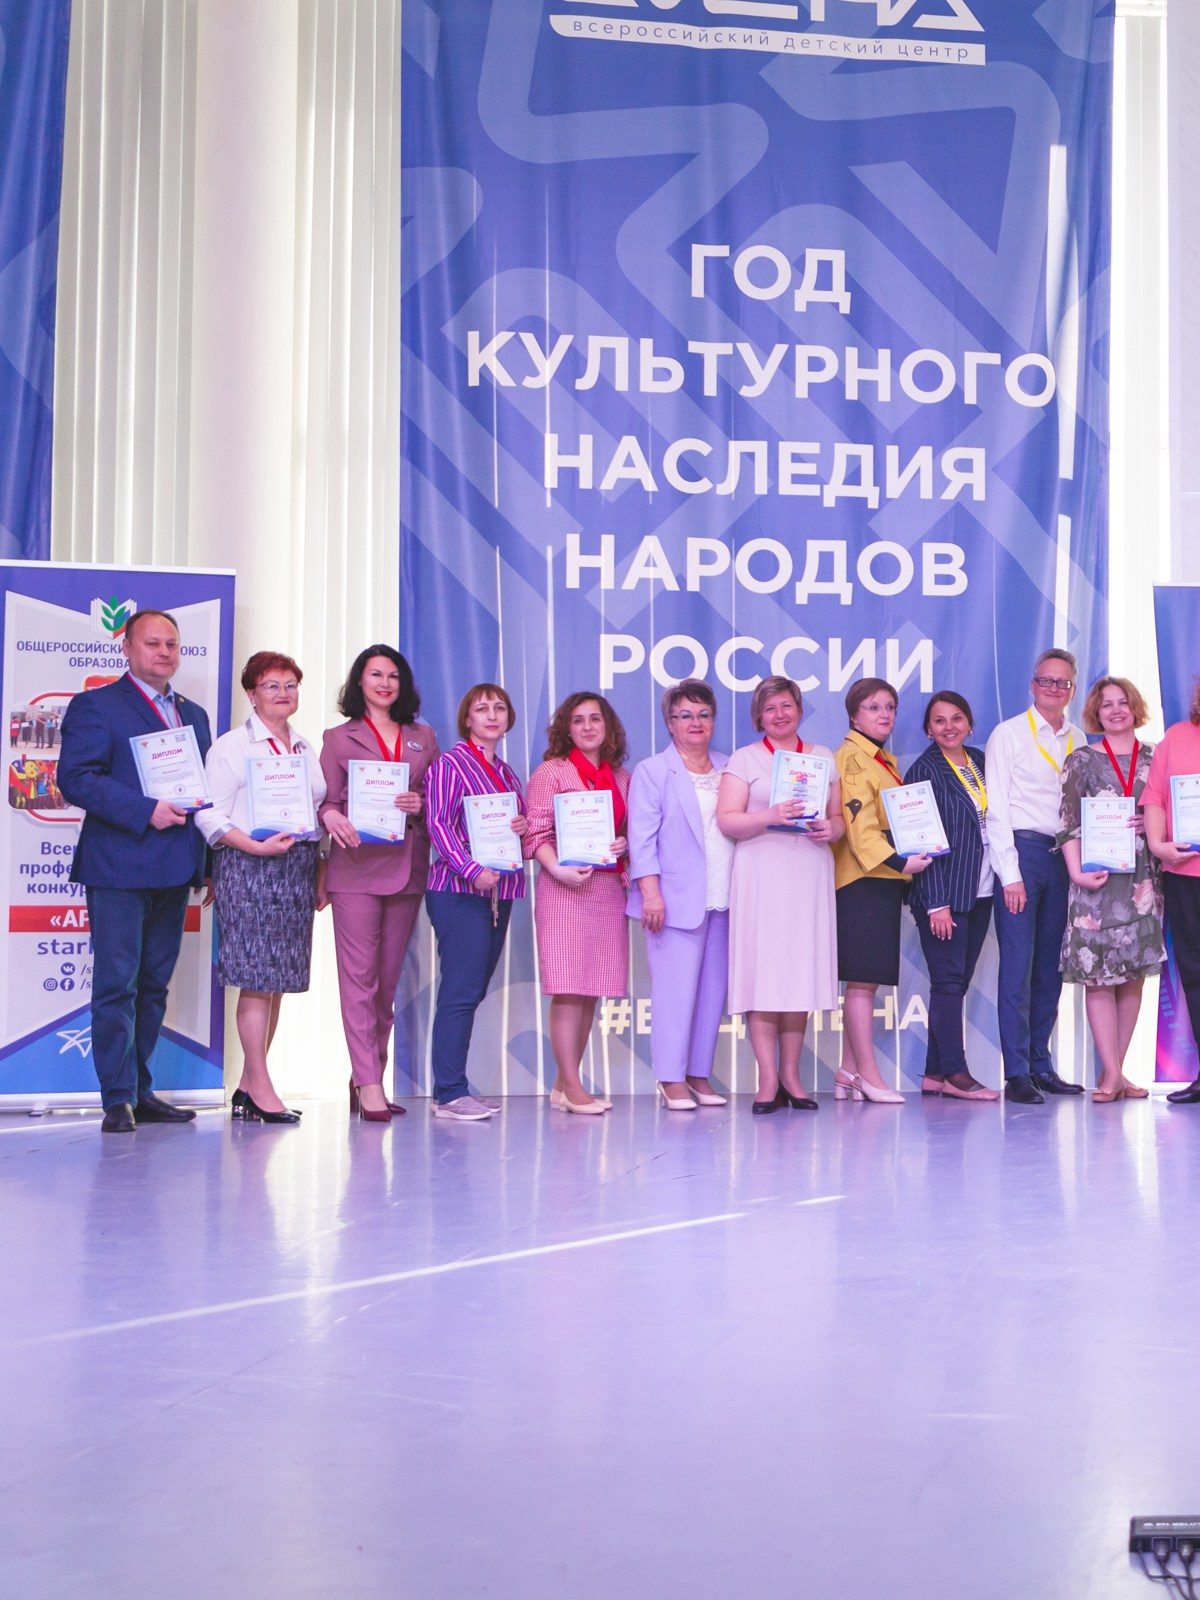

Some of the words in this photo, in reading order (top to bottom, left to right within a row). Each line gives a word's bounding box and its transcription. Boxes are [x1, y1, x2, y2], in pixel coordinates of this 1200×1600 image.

[573, 18, 770, 47] всероссийский
[784, 36, 884, 55] детский
[898, 42, 968, 62] центр
[691, 243, 852, 314] ГОД
[467, 330, 1057, 408] КУЛЬТУРНОГО
[544, 433, 986, 509] НАСЛЕДИЯ
[565, 533, 969, 605] НАРОДОВ
[16, 640, 124, 654] ОБЩЕРОССИЙСКИ
[69, 657, 130, 668] ОБРАЗОВА
[599, 634, 934, 694] РОССИИ
[151, 748, 183, 760] ДИПЛОМ
[264, 773, 296, 781] ДИПЛОМ
[365, 779, 395, 787] ДИПЛОМ
[19, 860, 73, 878] профе
[27, 882, 86, 898] конкур
[37, 938, 94, 955] star
